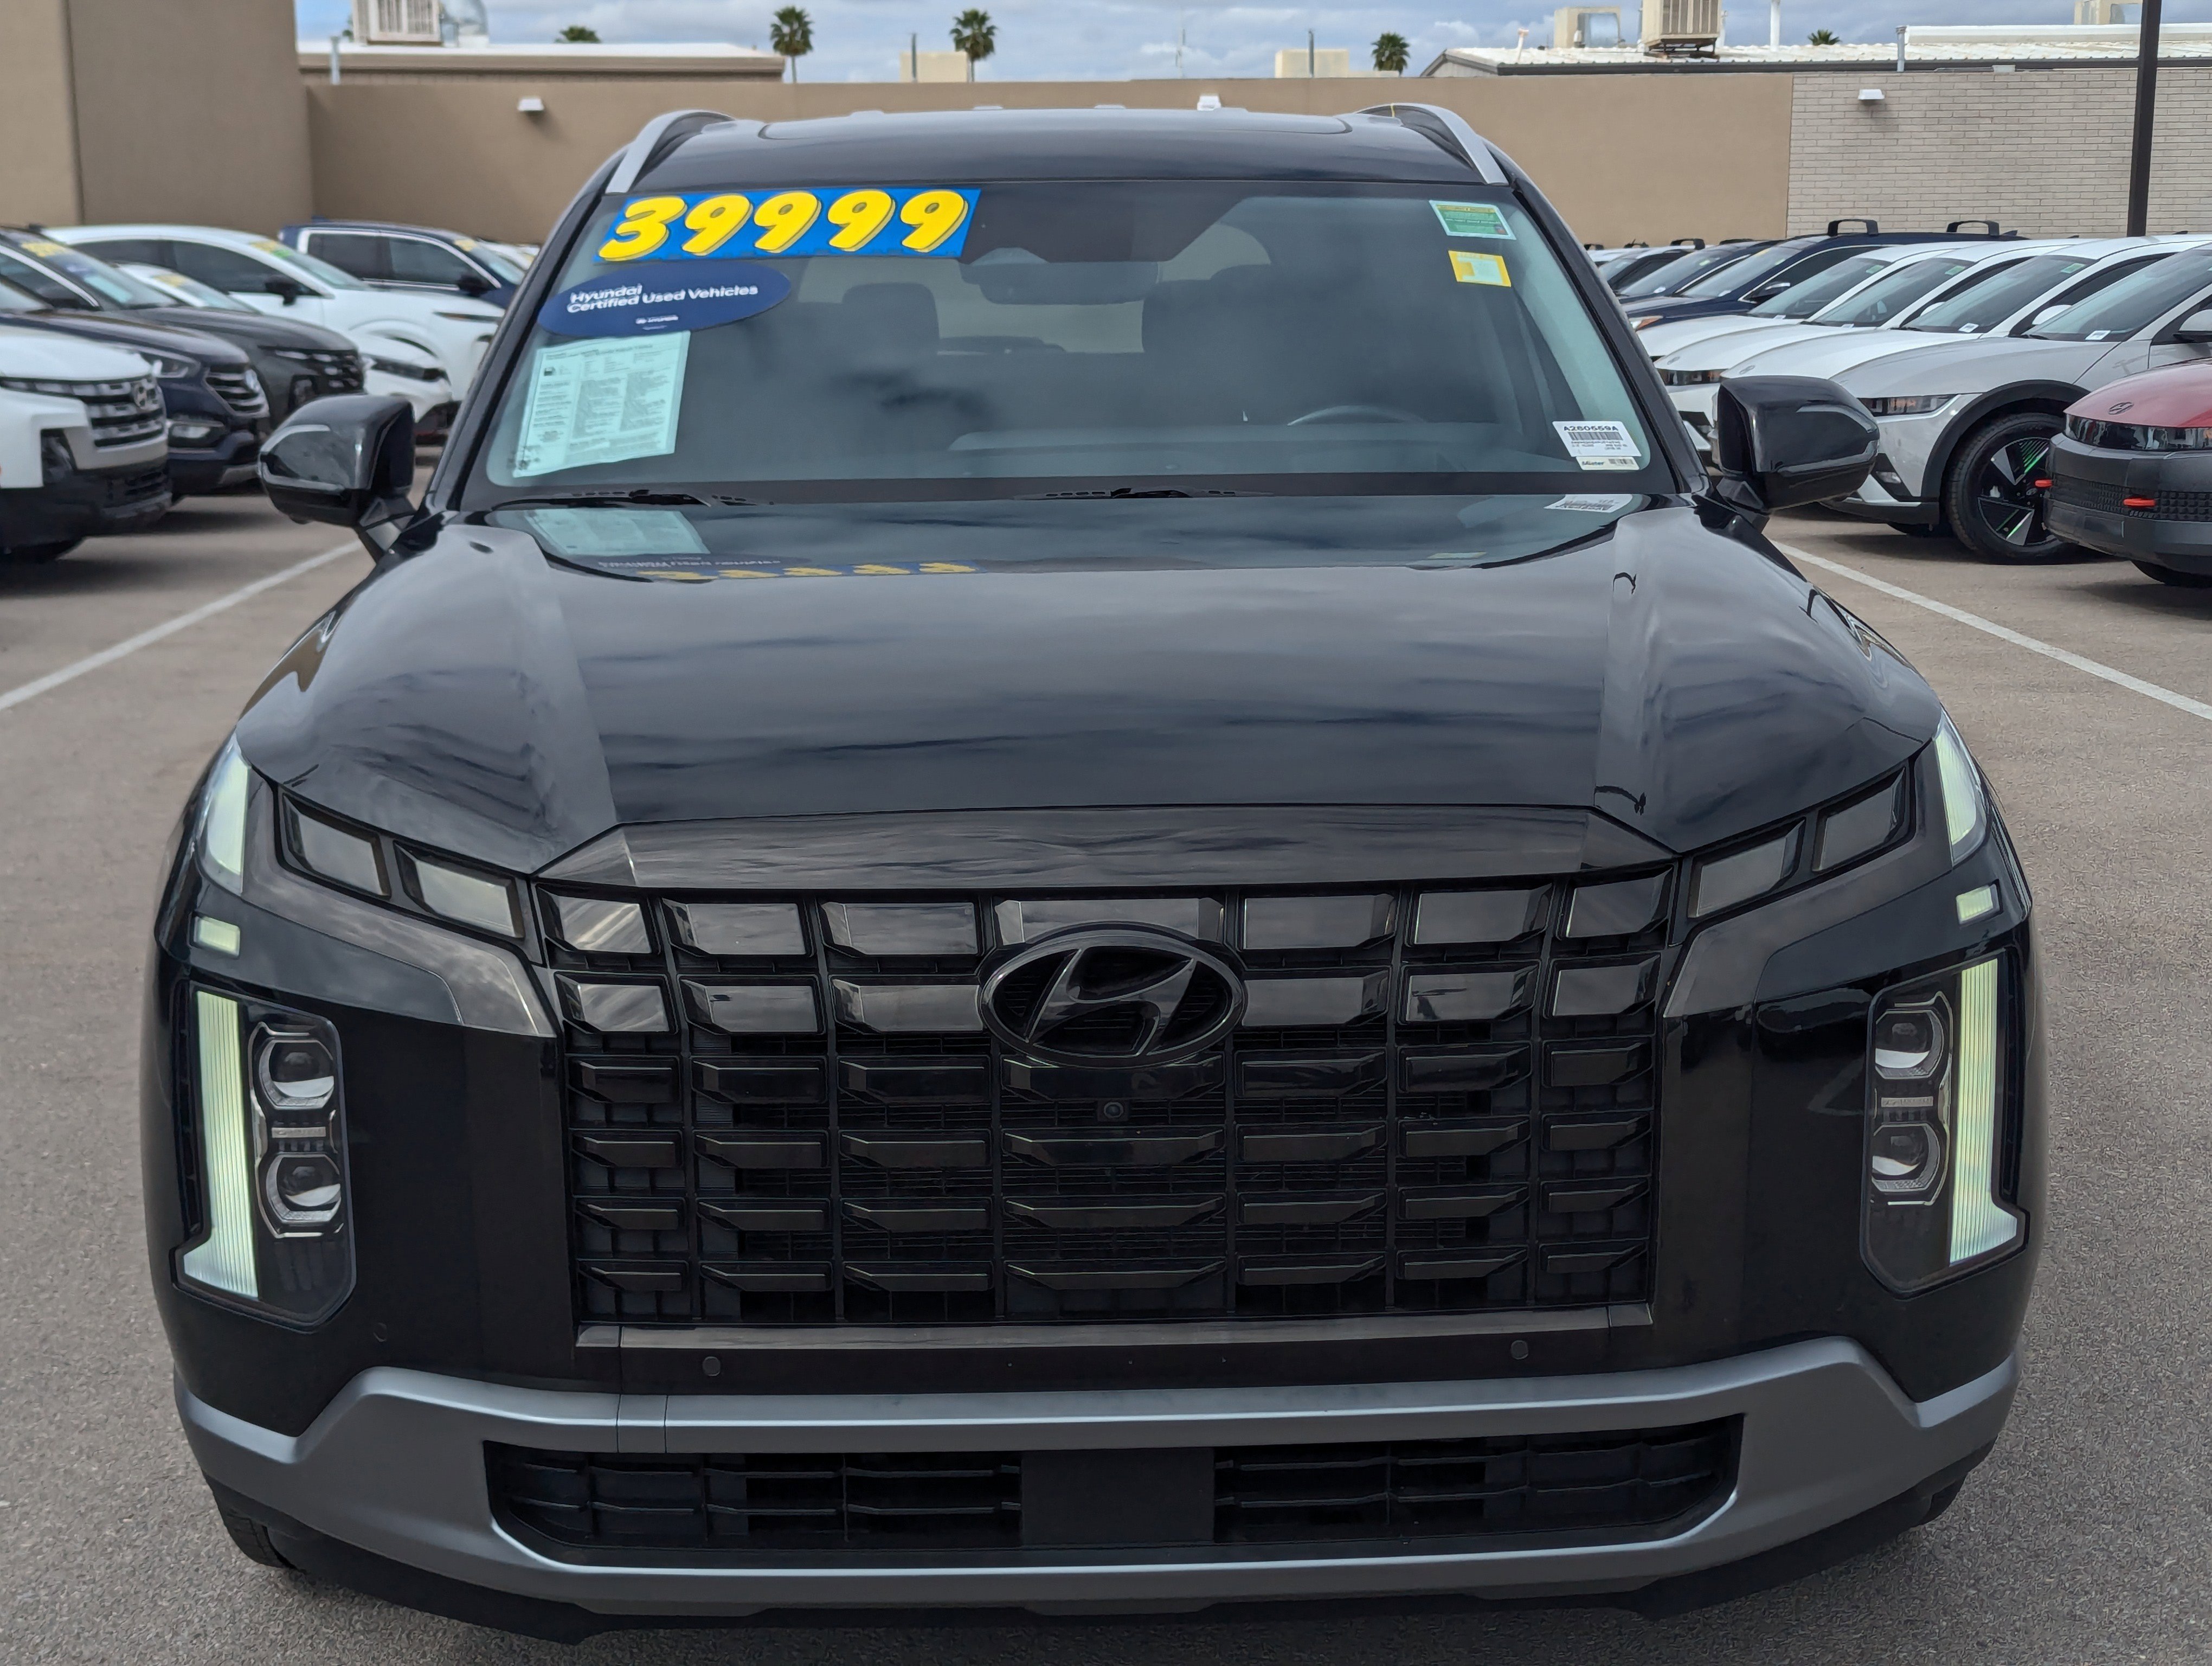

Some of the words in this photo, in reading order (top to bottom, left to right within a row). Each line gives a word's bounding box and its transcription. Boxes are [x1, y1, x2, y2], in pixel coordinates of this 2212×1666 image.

[598, 190, 968, 261] 39999
[567, 294, 639, 313] Certified
[642, 289, 686, 304] Used
[688, 285, 758, 299] Vehicles
[570, 284, 643, 304] Hyundai
